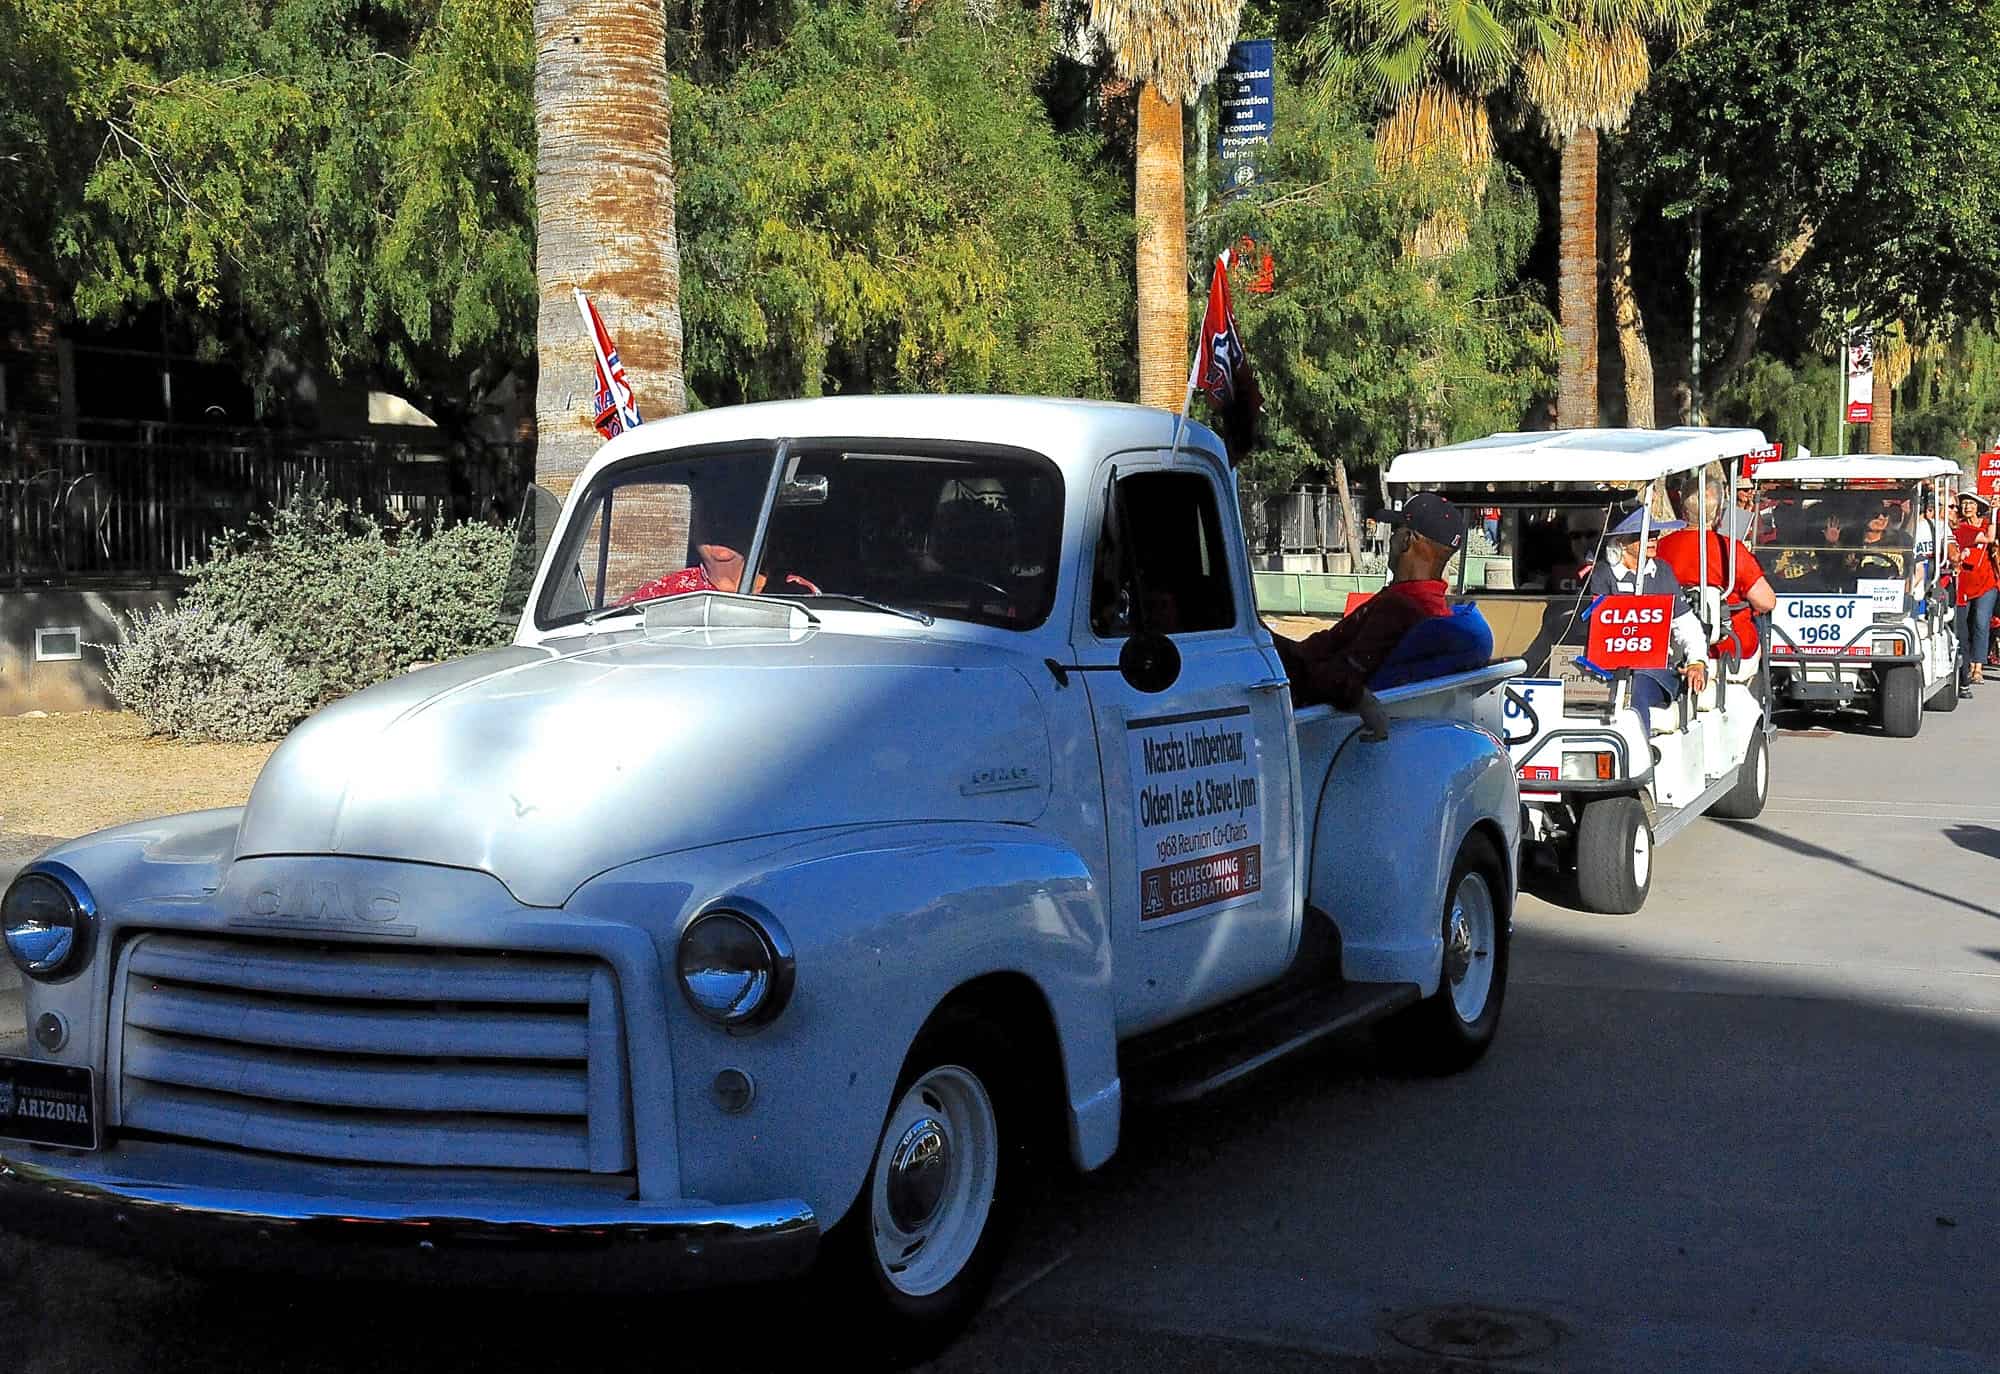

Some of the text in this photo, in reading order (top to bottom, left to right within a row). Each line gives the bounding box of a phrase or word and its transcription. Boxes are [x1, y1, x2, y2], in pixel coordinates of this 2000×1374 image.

[1239, 84, 1250, 93] an
[1222, 95, 1269, 107] Innovation
[1236, 109, 1254, 119] and
[1222, 135, 1268, 147] Prosperity
[1600, 608, 1663, 624] CLASS
[1788, 600, 1856, 618] Class of
[1622, 626, 1638, 636] OF
[1799, 624, 1841, 644] 1968
[1605, 637, 1652, 653] 1968
[1143, 731, 1187, 776] Marsha
[1140, 774, 1257, 828] Olden Lee & Steve Lynn
[1157, 820, 1248, 862] 1968 Reunion Co-Chairs
[1170, 857, 1239, 888] HOMECOMING
[1171, 875, 1239, 906] CELEBRATION
[17, 1097, 89, 1124] ARIZONA
